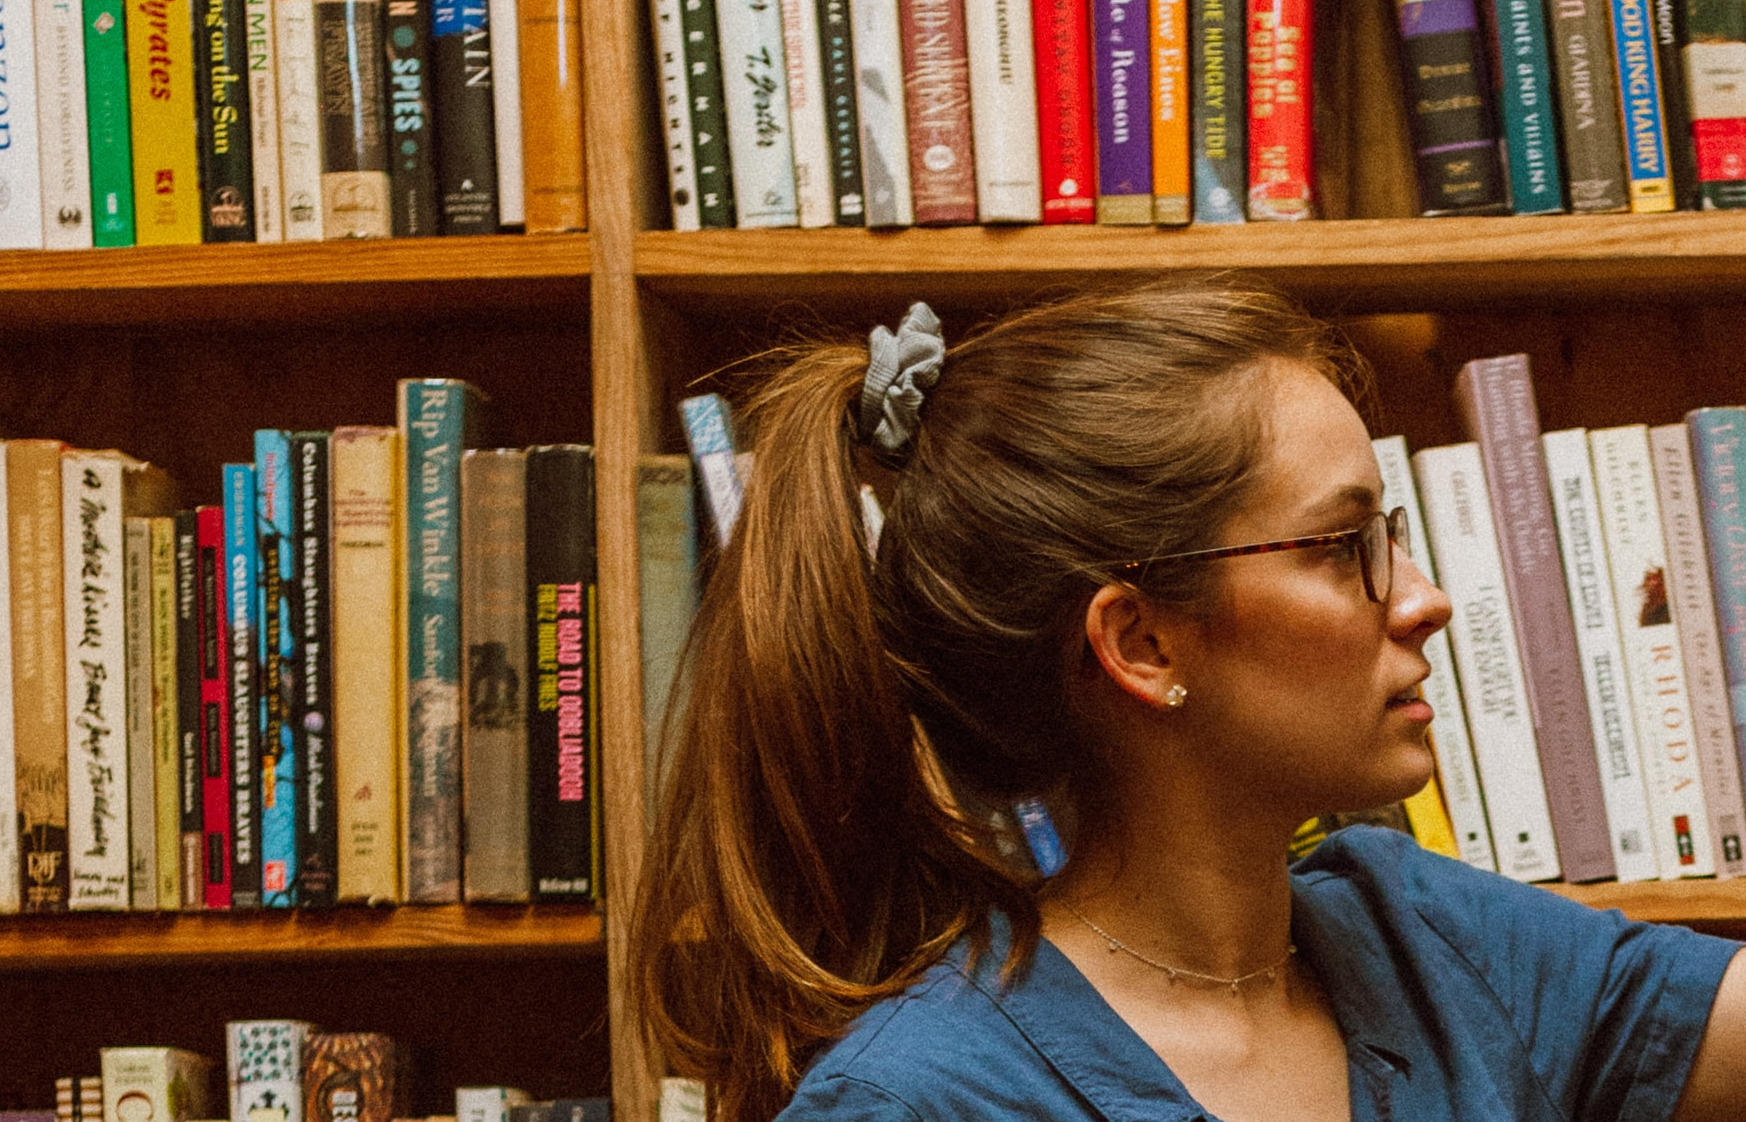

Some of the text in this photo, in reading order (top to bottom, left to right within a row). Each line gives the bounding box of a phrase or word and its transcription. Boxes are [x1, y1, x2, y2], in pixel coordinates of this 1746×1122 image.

[249, 13, 268, 72] MEN
[1157, 47, 1182, 121] Lines
[1248, 12, 1279, 119] Poppies
[1276, 26, 1300, 105] Sea of
[1567, 34, 1596, 131] GIARDINA
[210, 31, 240, 155] on the Sun
[392, 57, 424, 133] SPIES
[1110, 49, 1136, 144] Reason
[1203, 28, 1227, 160] HUNGRY TIDE
[1624, 40, 1660, 174] KING HARRY
[411, 388, 451, 598] Rip Van Winkle
[1662, 445, 1685, 501] Ellen
[301, 441, 321, 705] Columbus Slaughters Braves
[556, 582, 583, 614] THE
[556, 618, 583, 664] ROAD
[557, 667, 584, 692] TO
[232, 553, 252, 865] COLUMBUS SLAUGHTERS BRAVES
[1650, 643, 1693, 793] RHODA
